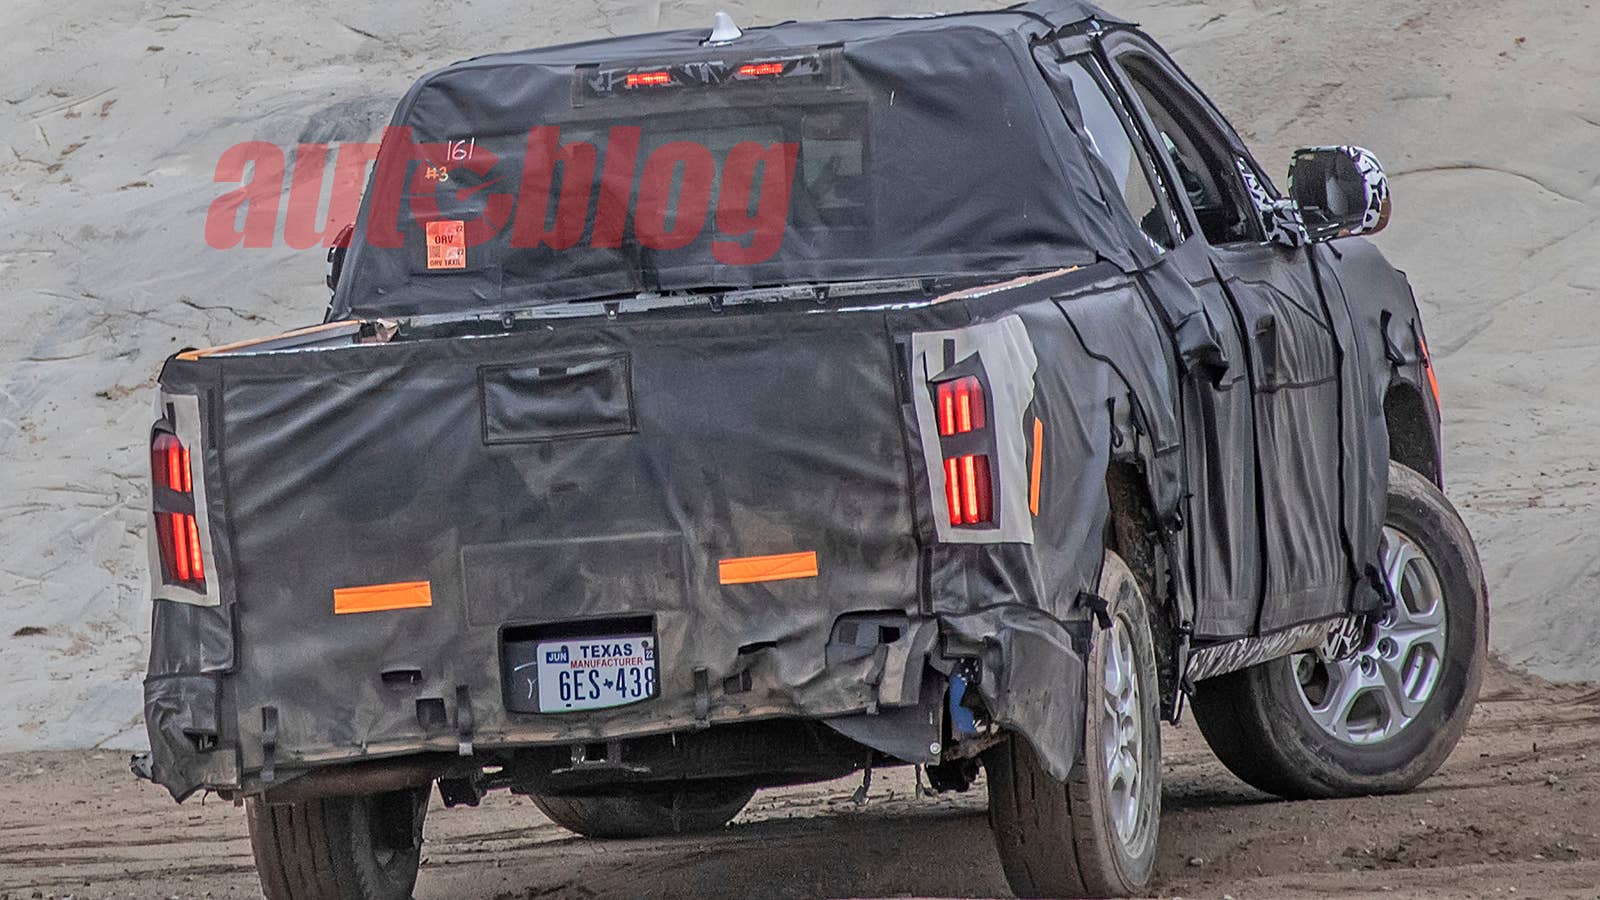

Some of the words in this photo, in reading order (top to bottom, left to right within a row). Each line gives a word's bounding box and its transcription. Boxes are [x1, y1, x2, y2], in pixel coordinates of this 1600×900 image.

[447, 136, 475, 161] 161
[424, 166, 449, 183] #3
[434, 235, 454, 245] ORV
[580, 643, 633, 659] TEXAS
[645, 650, 654, 659] 22
[548, 653, 568, 662] JUN
[570, 657, 643, 669] MANUFACTURER
